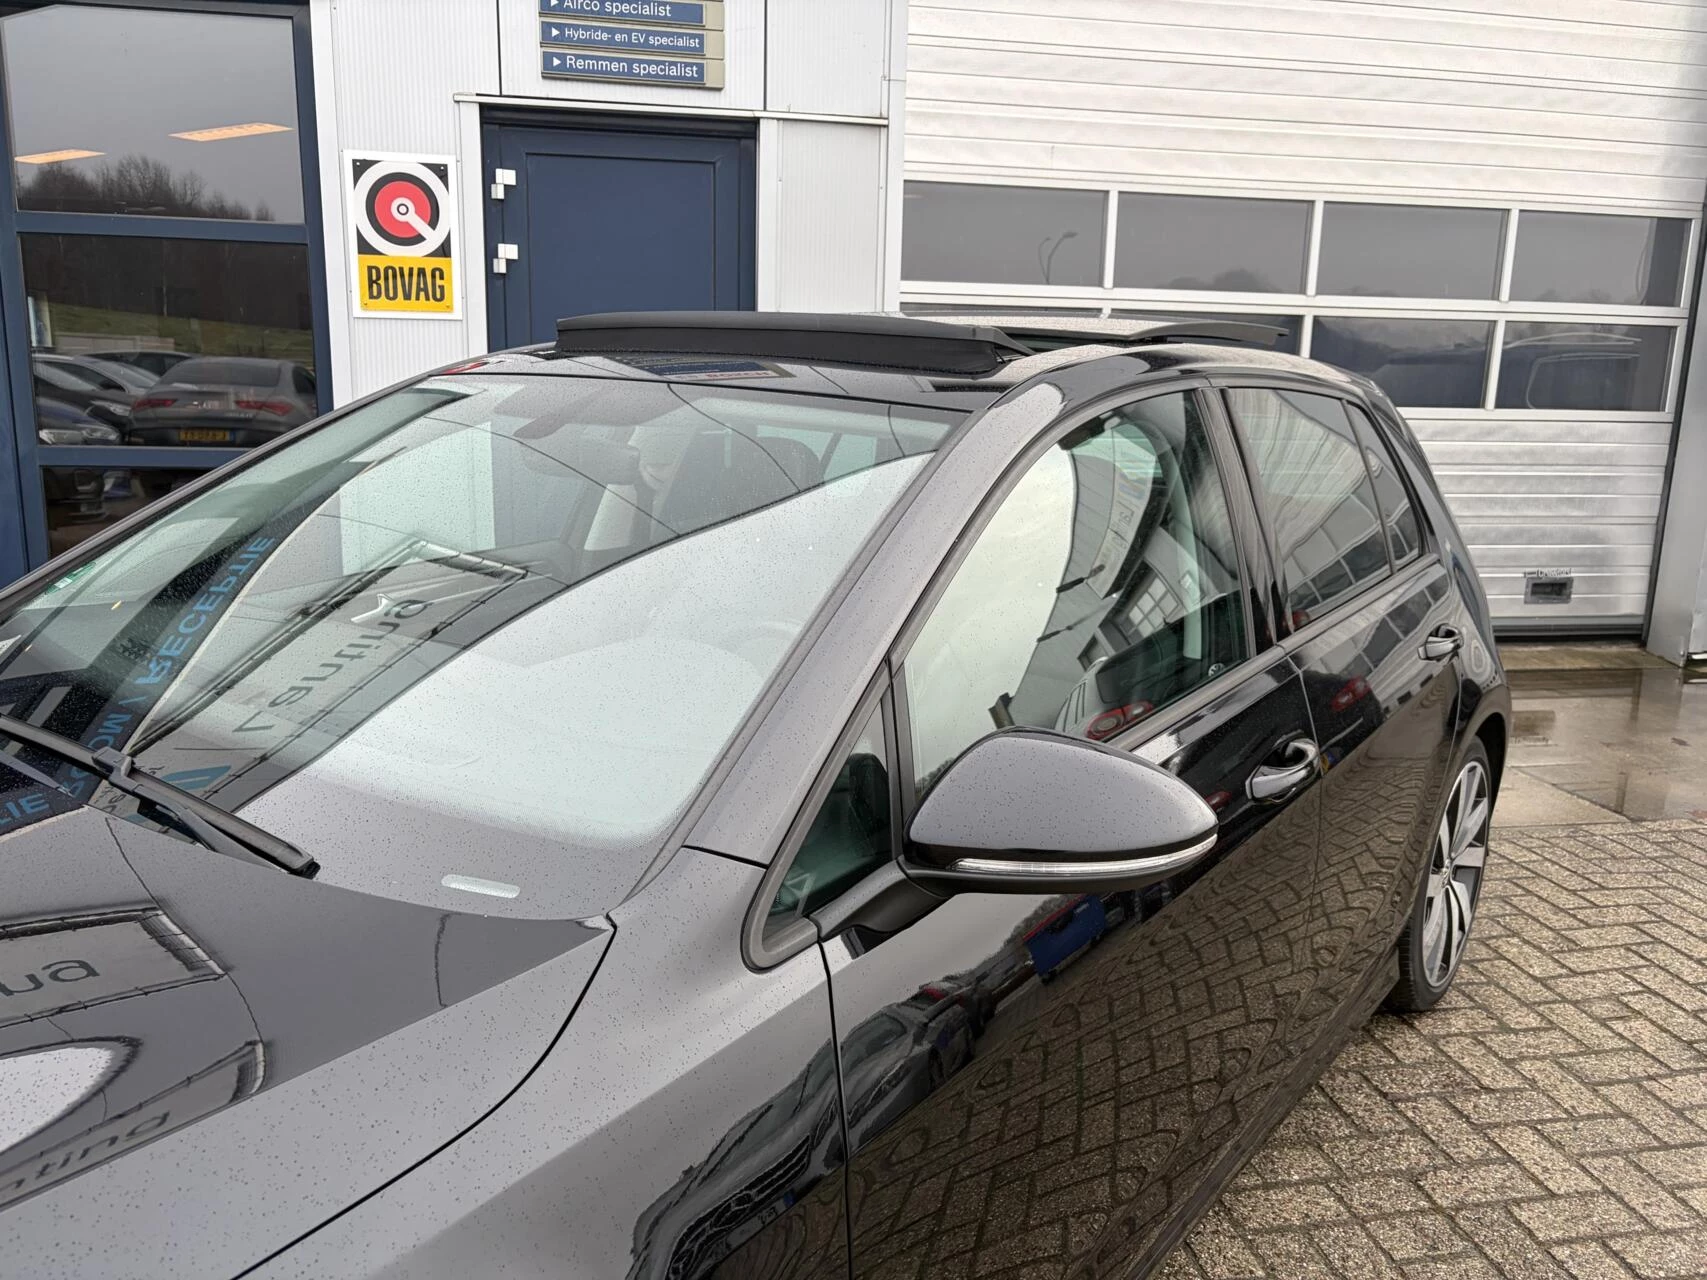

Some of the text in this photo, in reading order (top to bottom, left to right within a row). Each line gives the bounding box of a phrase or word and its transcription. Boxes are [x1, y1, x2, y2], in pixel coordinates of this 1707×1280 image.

[563, 0, 672, 17] Airco specialist
[565, 27, 700, 48] Hybride- en EV specialist
[566, 56, 698, 77] Remmen specialist
[367, 265, 446, 302] BOVAG
